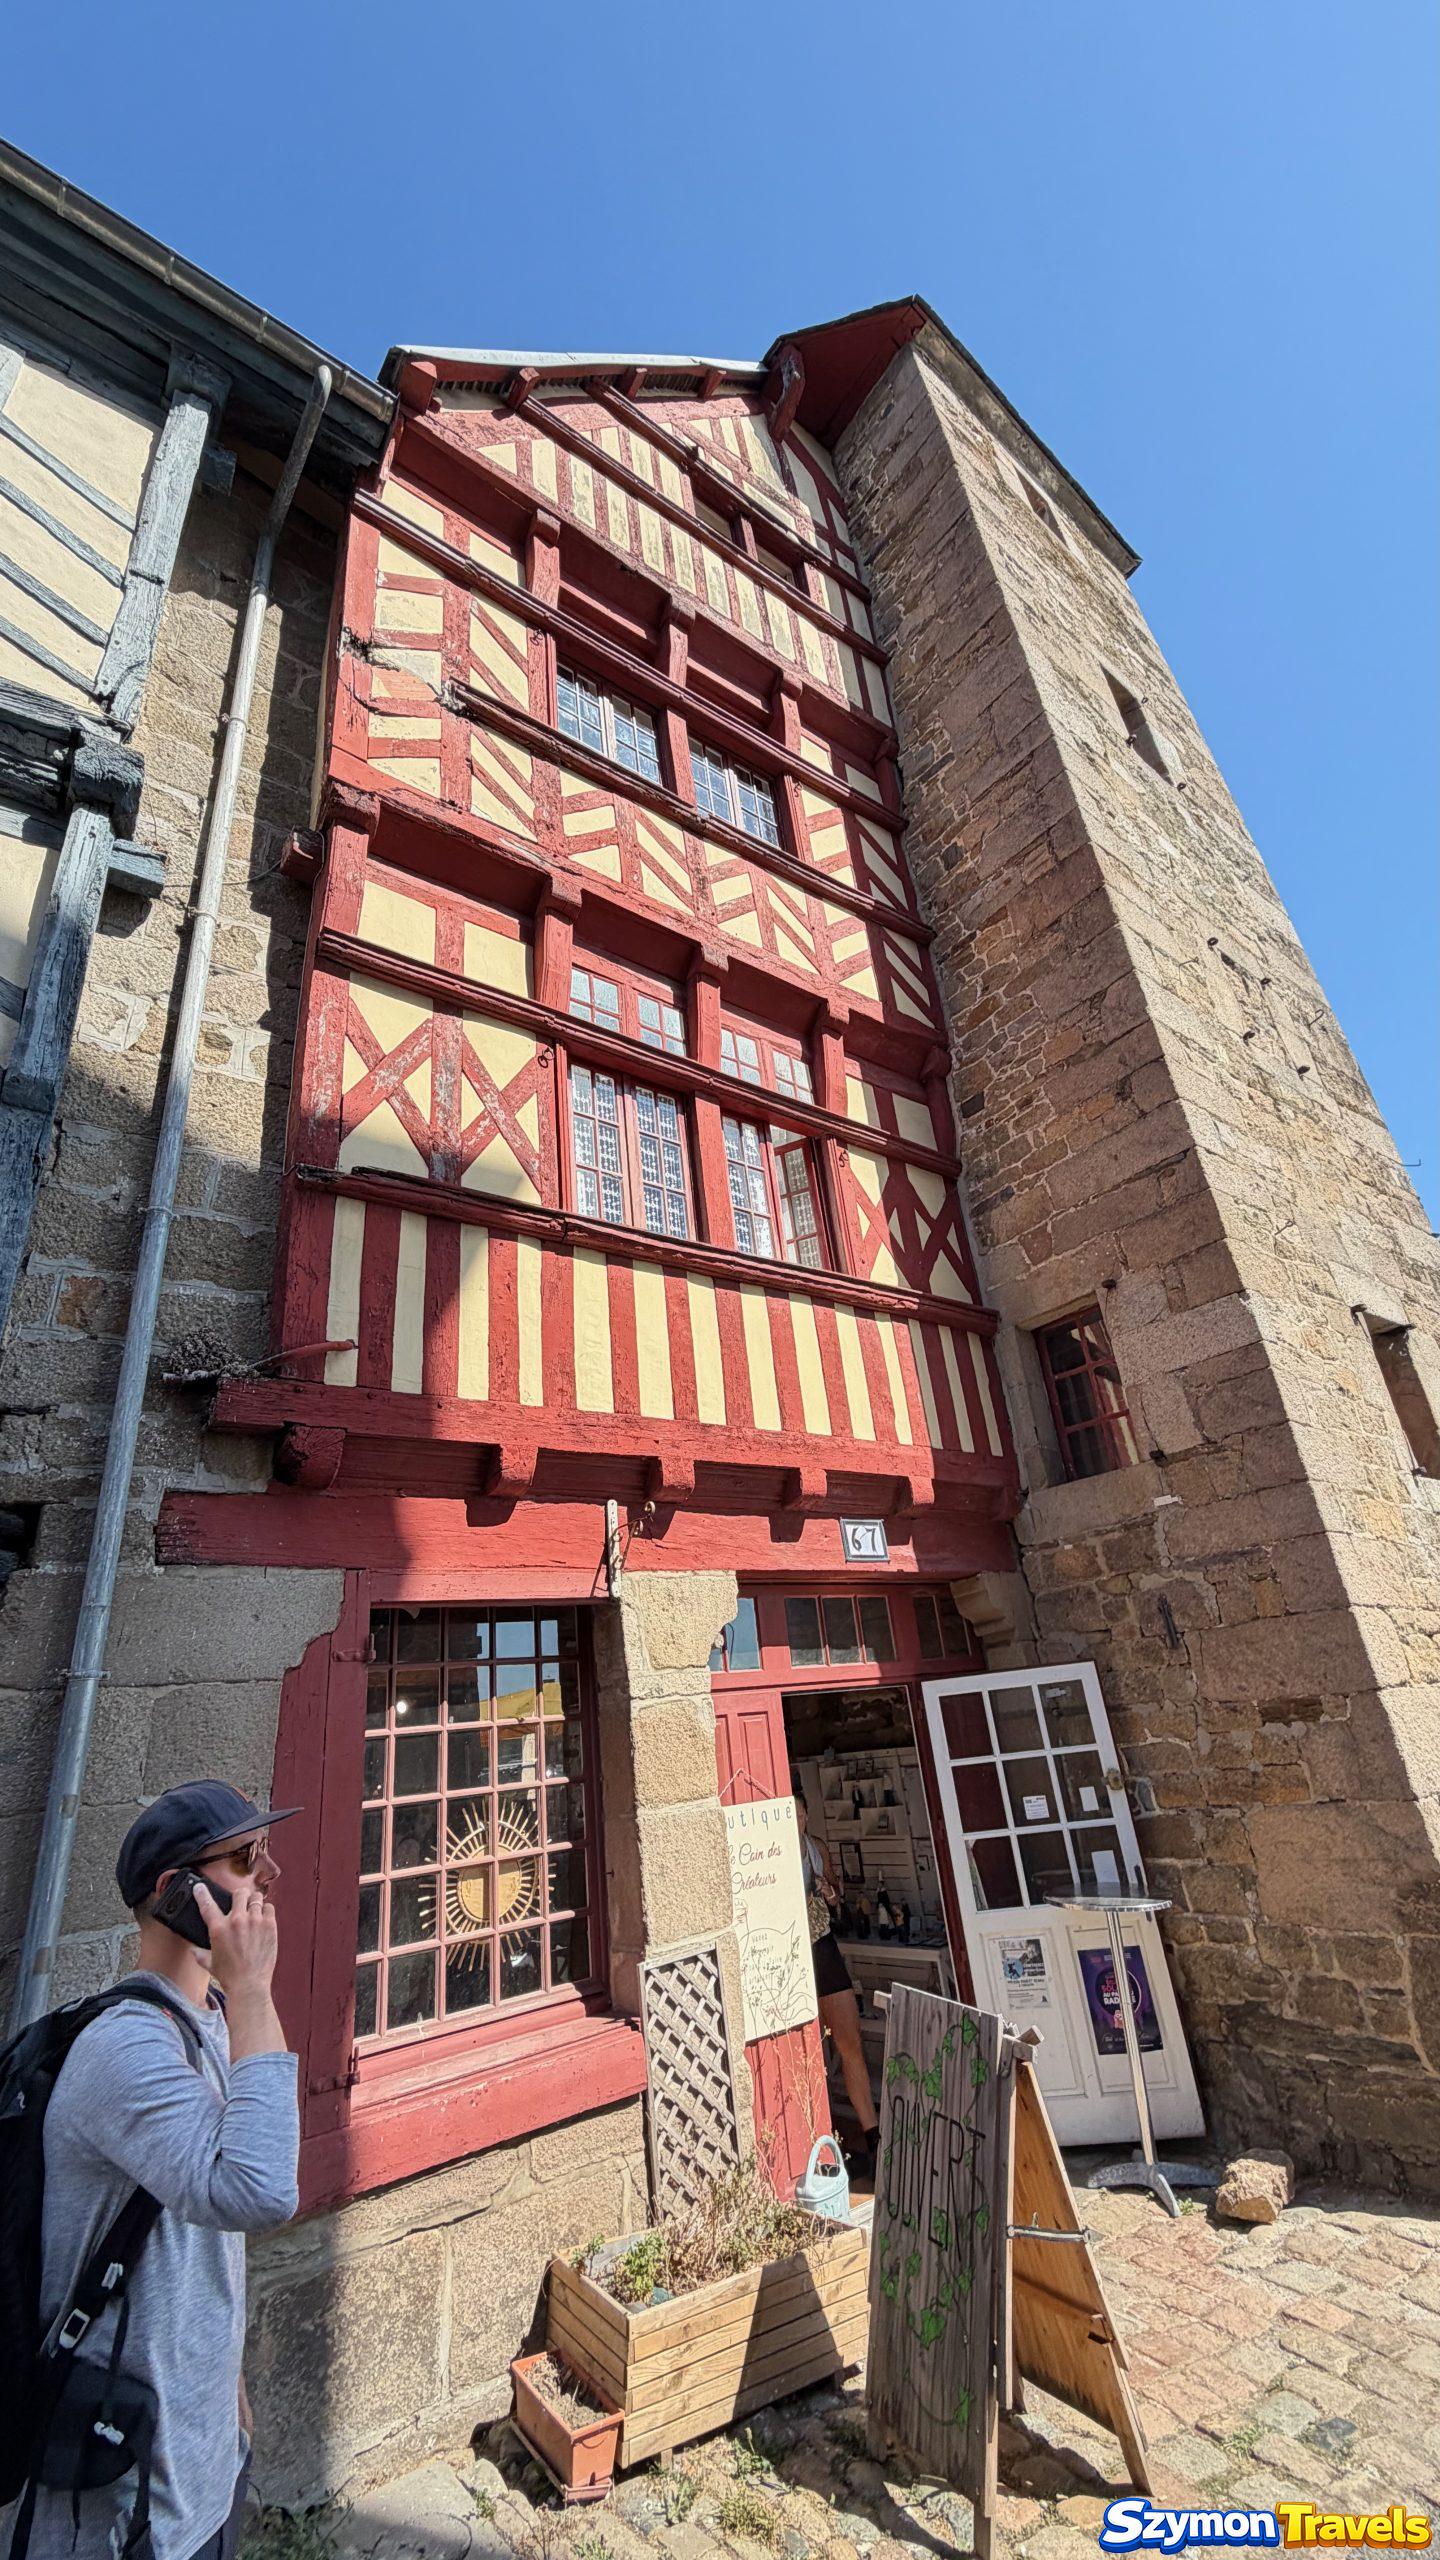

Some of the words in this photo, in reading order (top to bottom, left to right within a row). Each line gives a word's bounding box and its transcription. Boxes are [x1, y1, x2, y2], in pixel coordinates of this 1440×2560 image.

[851, 1526, 878, 1554] 67
[739, 1842, 765, 1866] Coin
[767, 1841, 782, 1859] des
